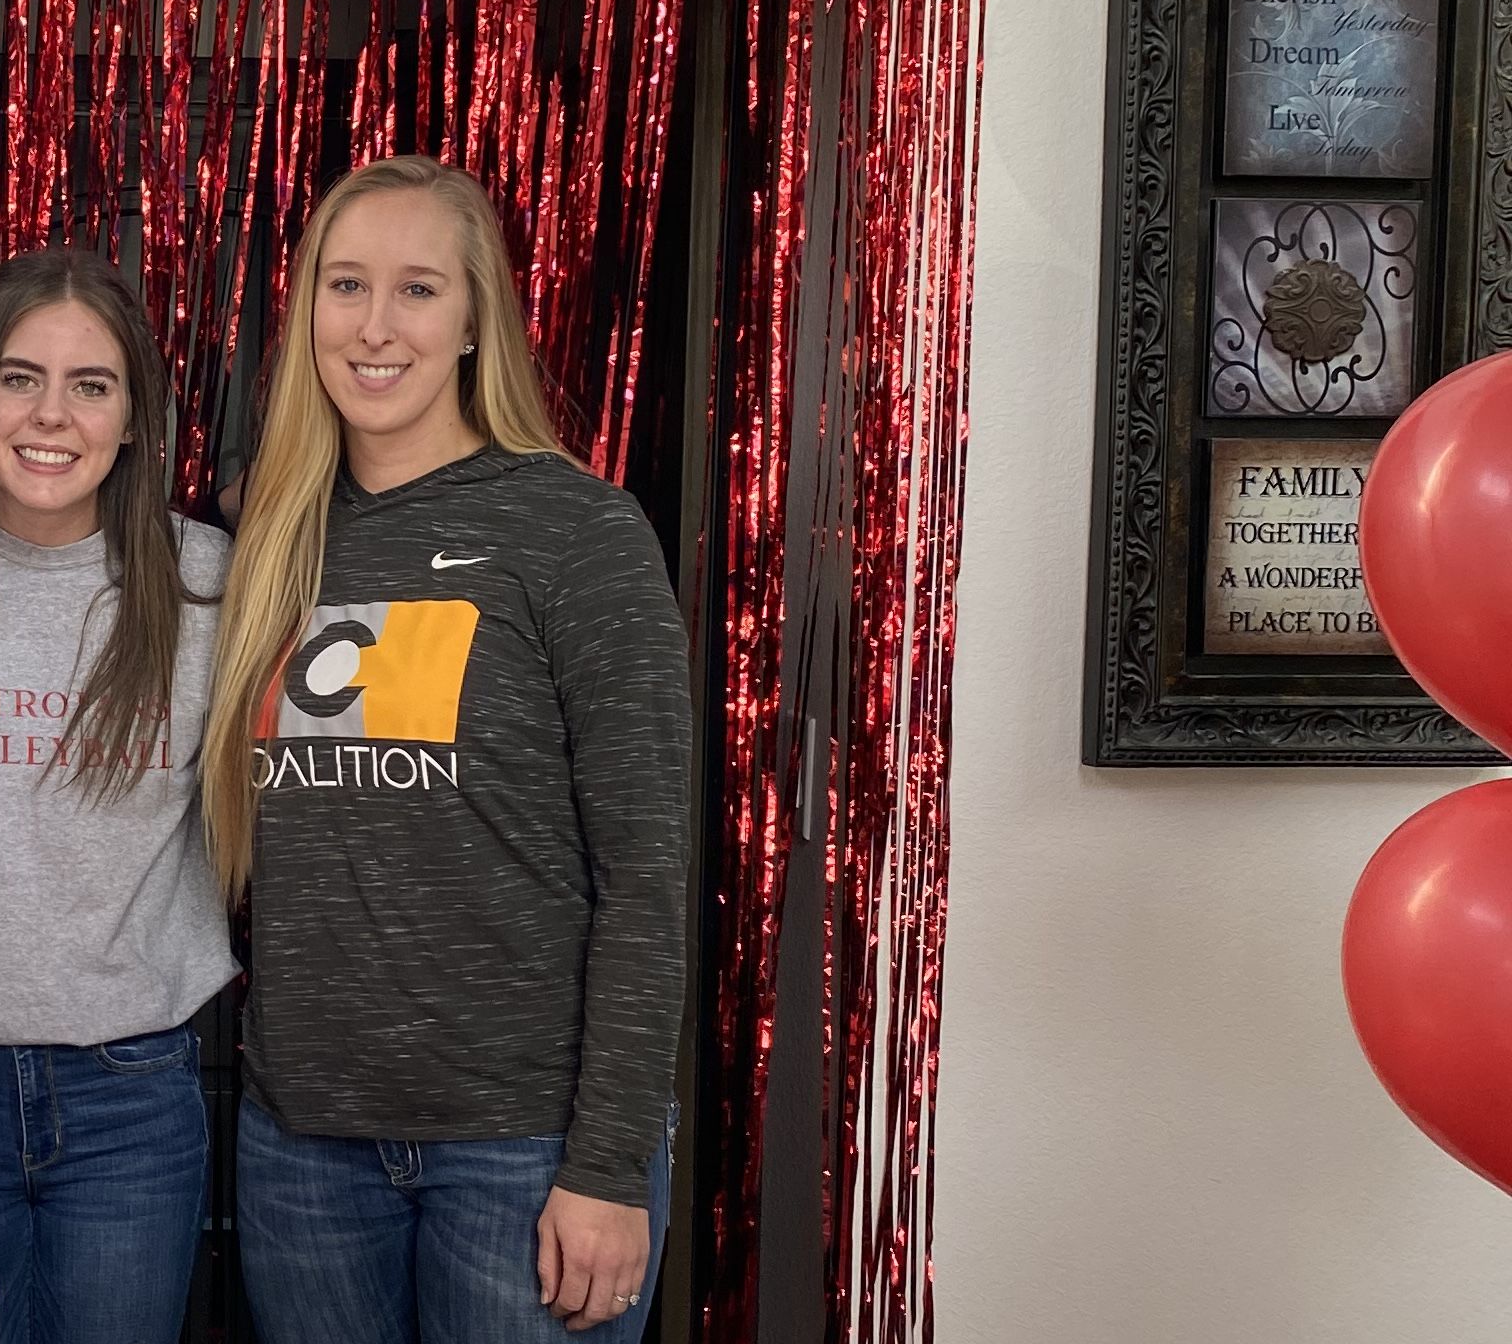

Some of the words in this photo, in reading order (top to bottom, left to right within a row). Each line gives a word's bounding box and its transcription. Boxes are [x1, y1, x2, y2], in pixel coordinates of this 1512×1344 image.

[1329, 9, 1432, 37] Yesterday
[1249, 37, 1340, 65] Dream
[1309, 74, 1408, 98] Tomorrow
[1269, 105, 1321, 130] Live
[1313, 134, 1374, 162] Today
[1225, 522, 1359, 545] TOGETHER
[1217, 567, 1237, 589] A
[1245, 563, 1363, 590] WONDERF
[1228, 611, 1310, 634] PLACE
[1318, 611, 1350, 634] TO
[252, 745, 458, 790] OALITION
